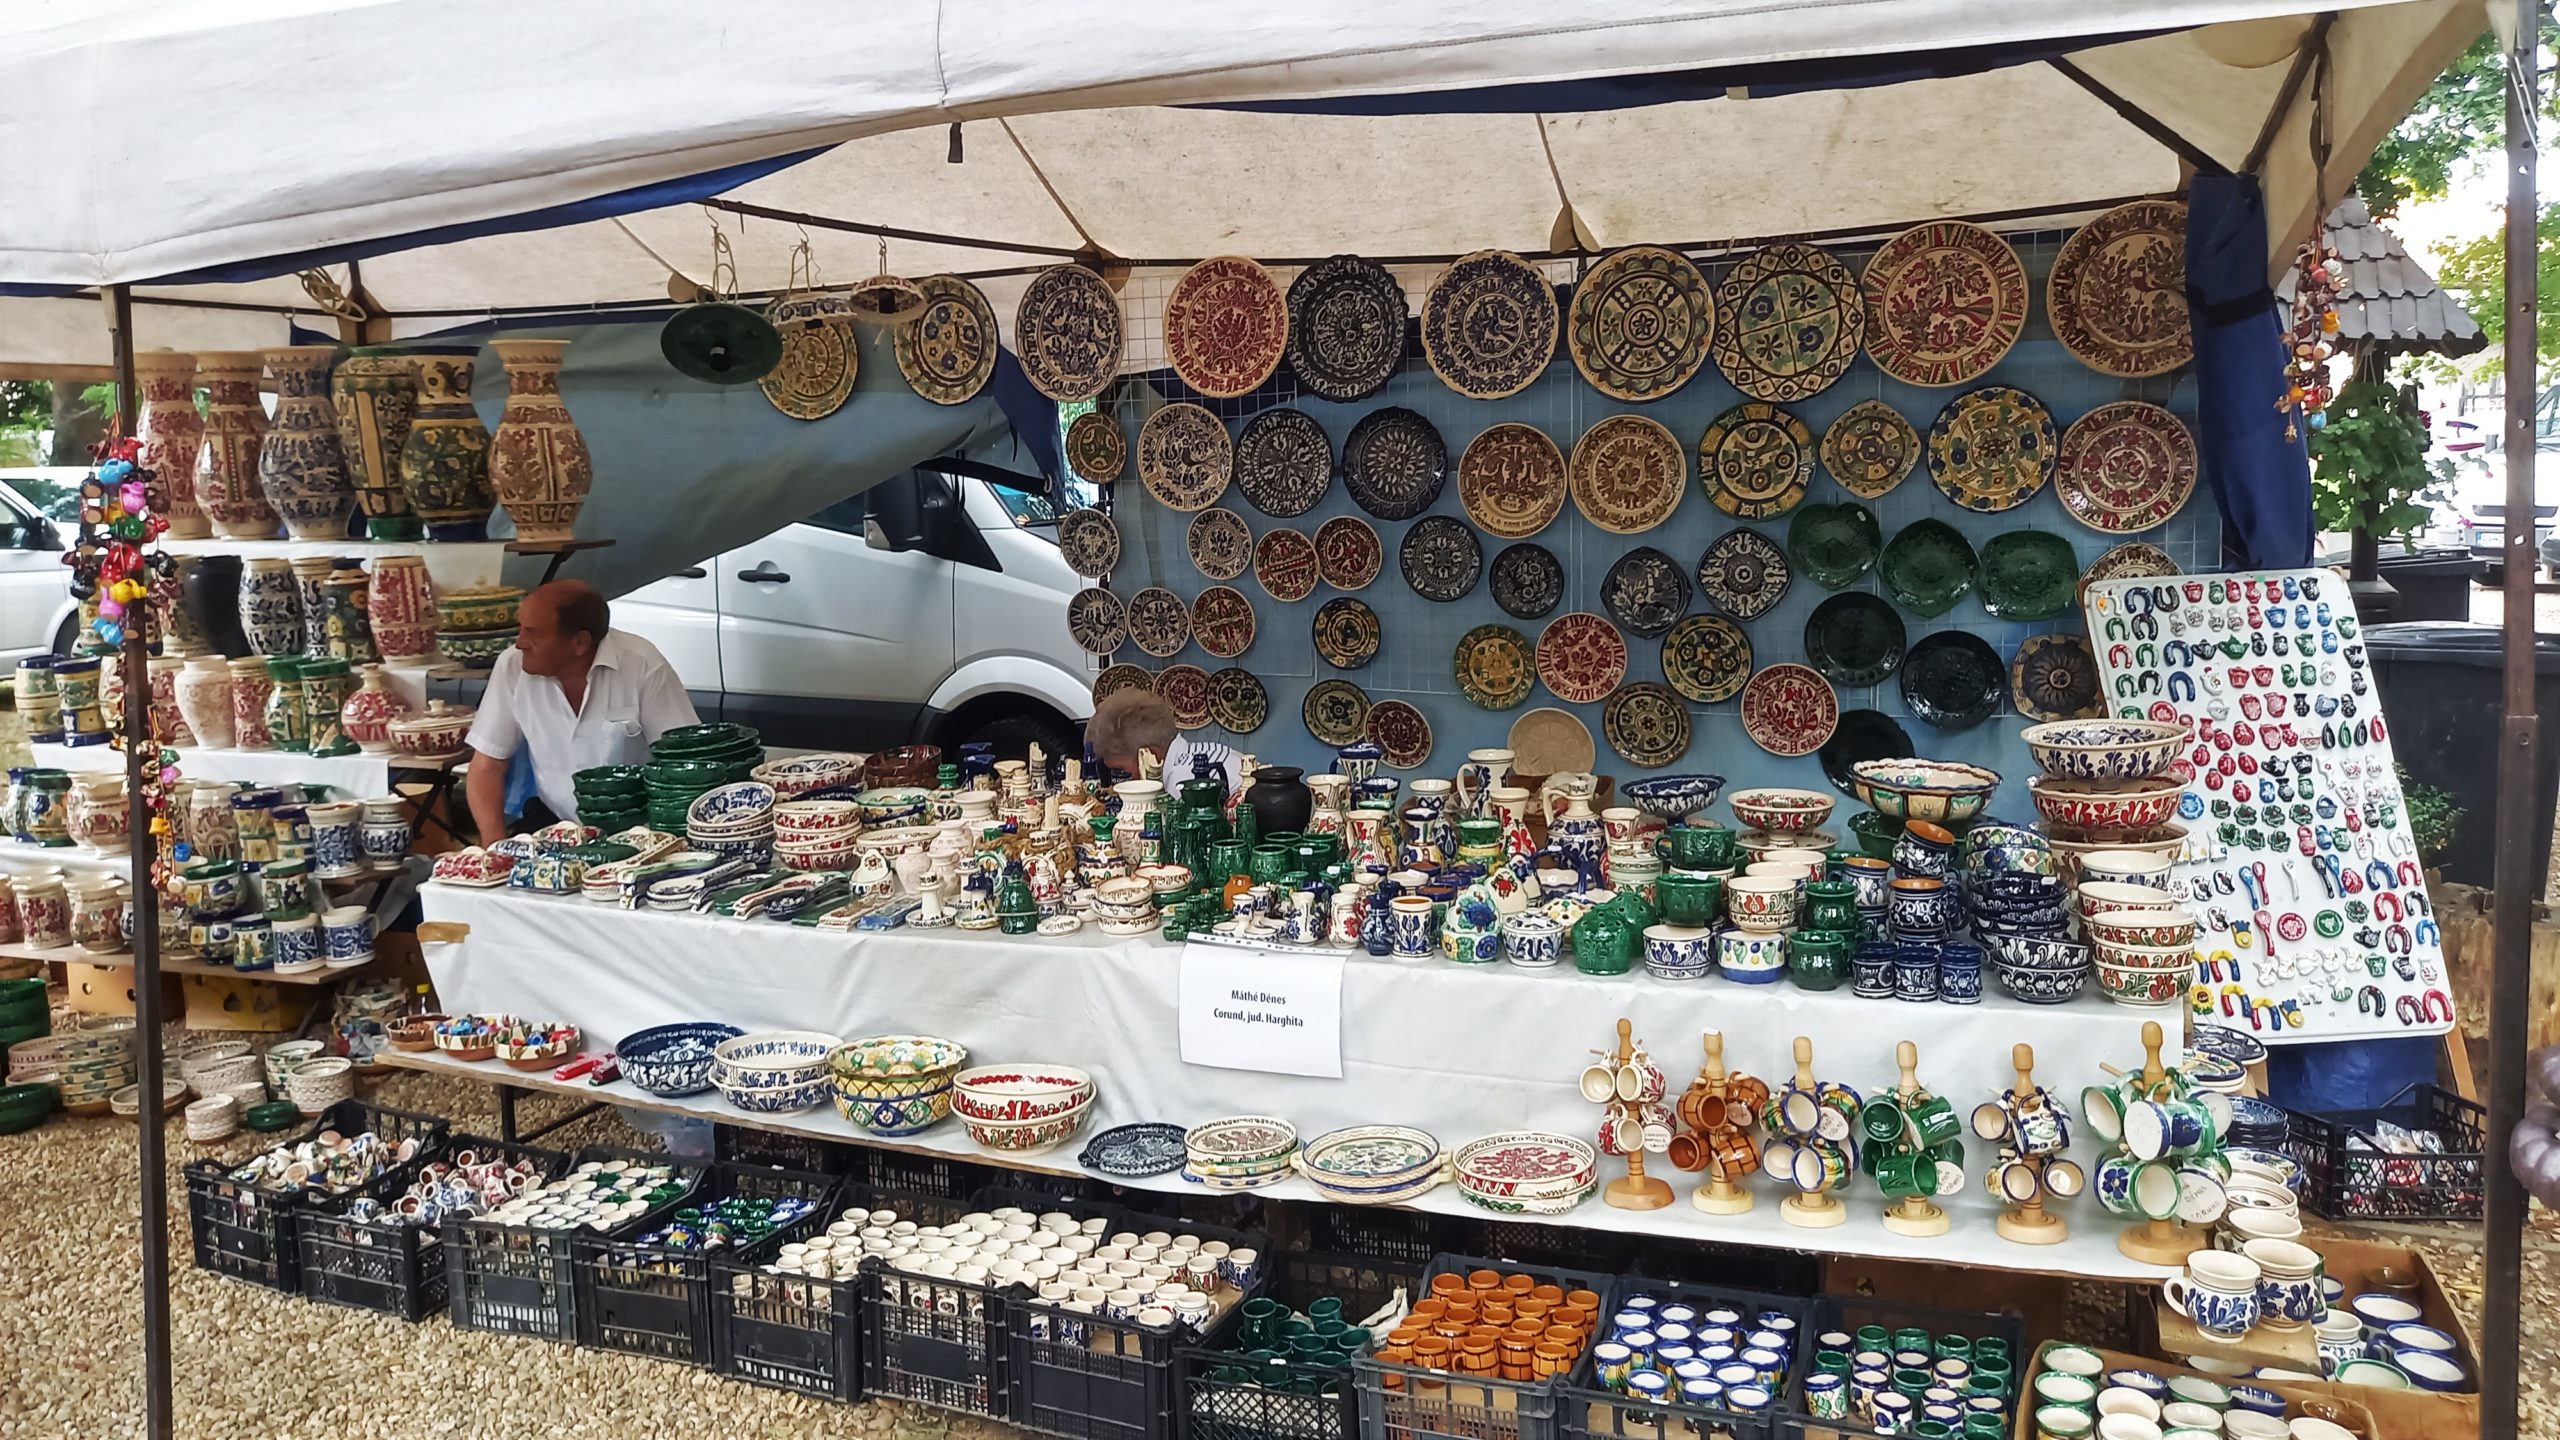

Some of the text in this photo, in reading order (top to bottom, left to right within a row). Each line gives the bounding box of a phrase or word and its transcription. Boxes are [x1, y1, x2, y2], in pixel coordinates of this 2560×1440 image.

[1231, 989, 1286, 1005] Máthé Dénes
[1213, 1008, 1304, 1028] Corund, jud. Harghita
